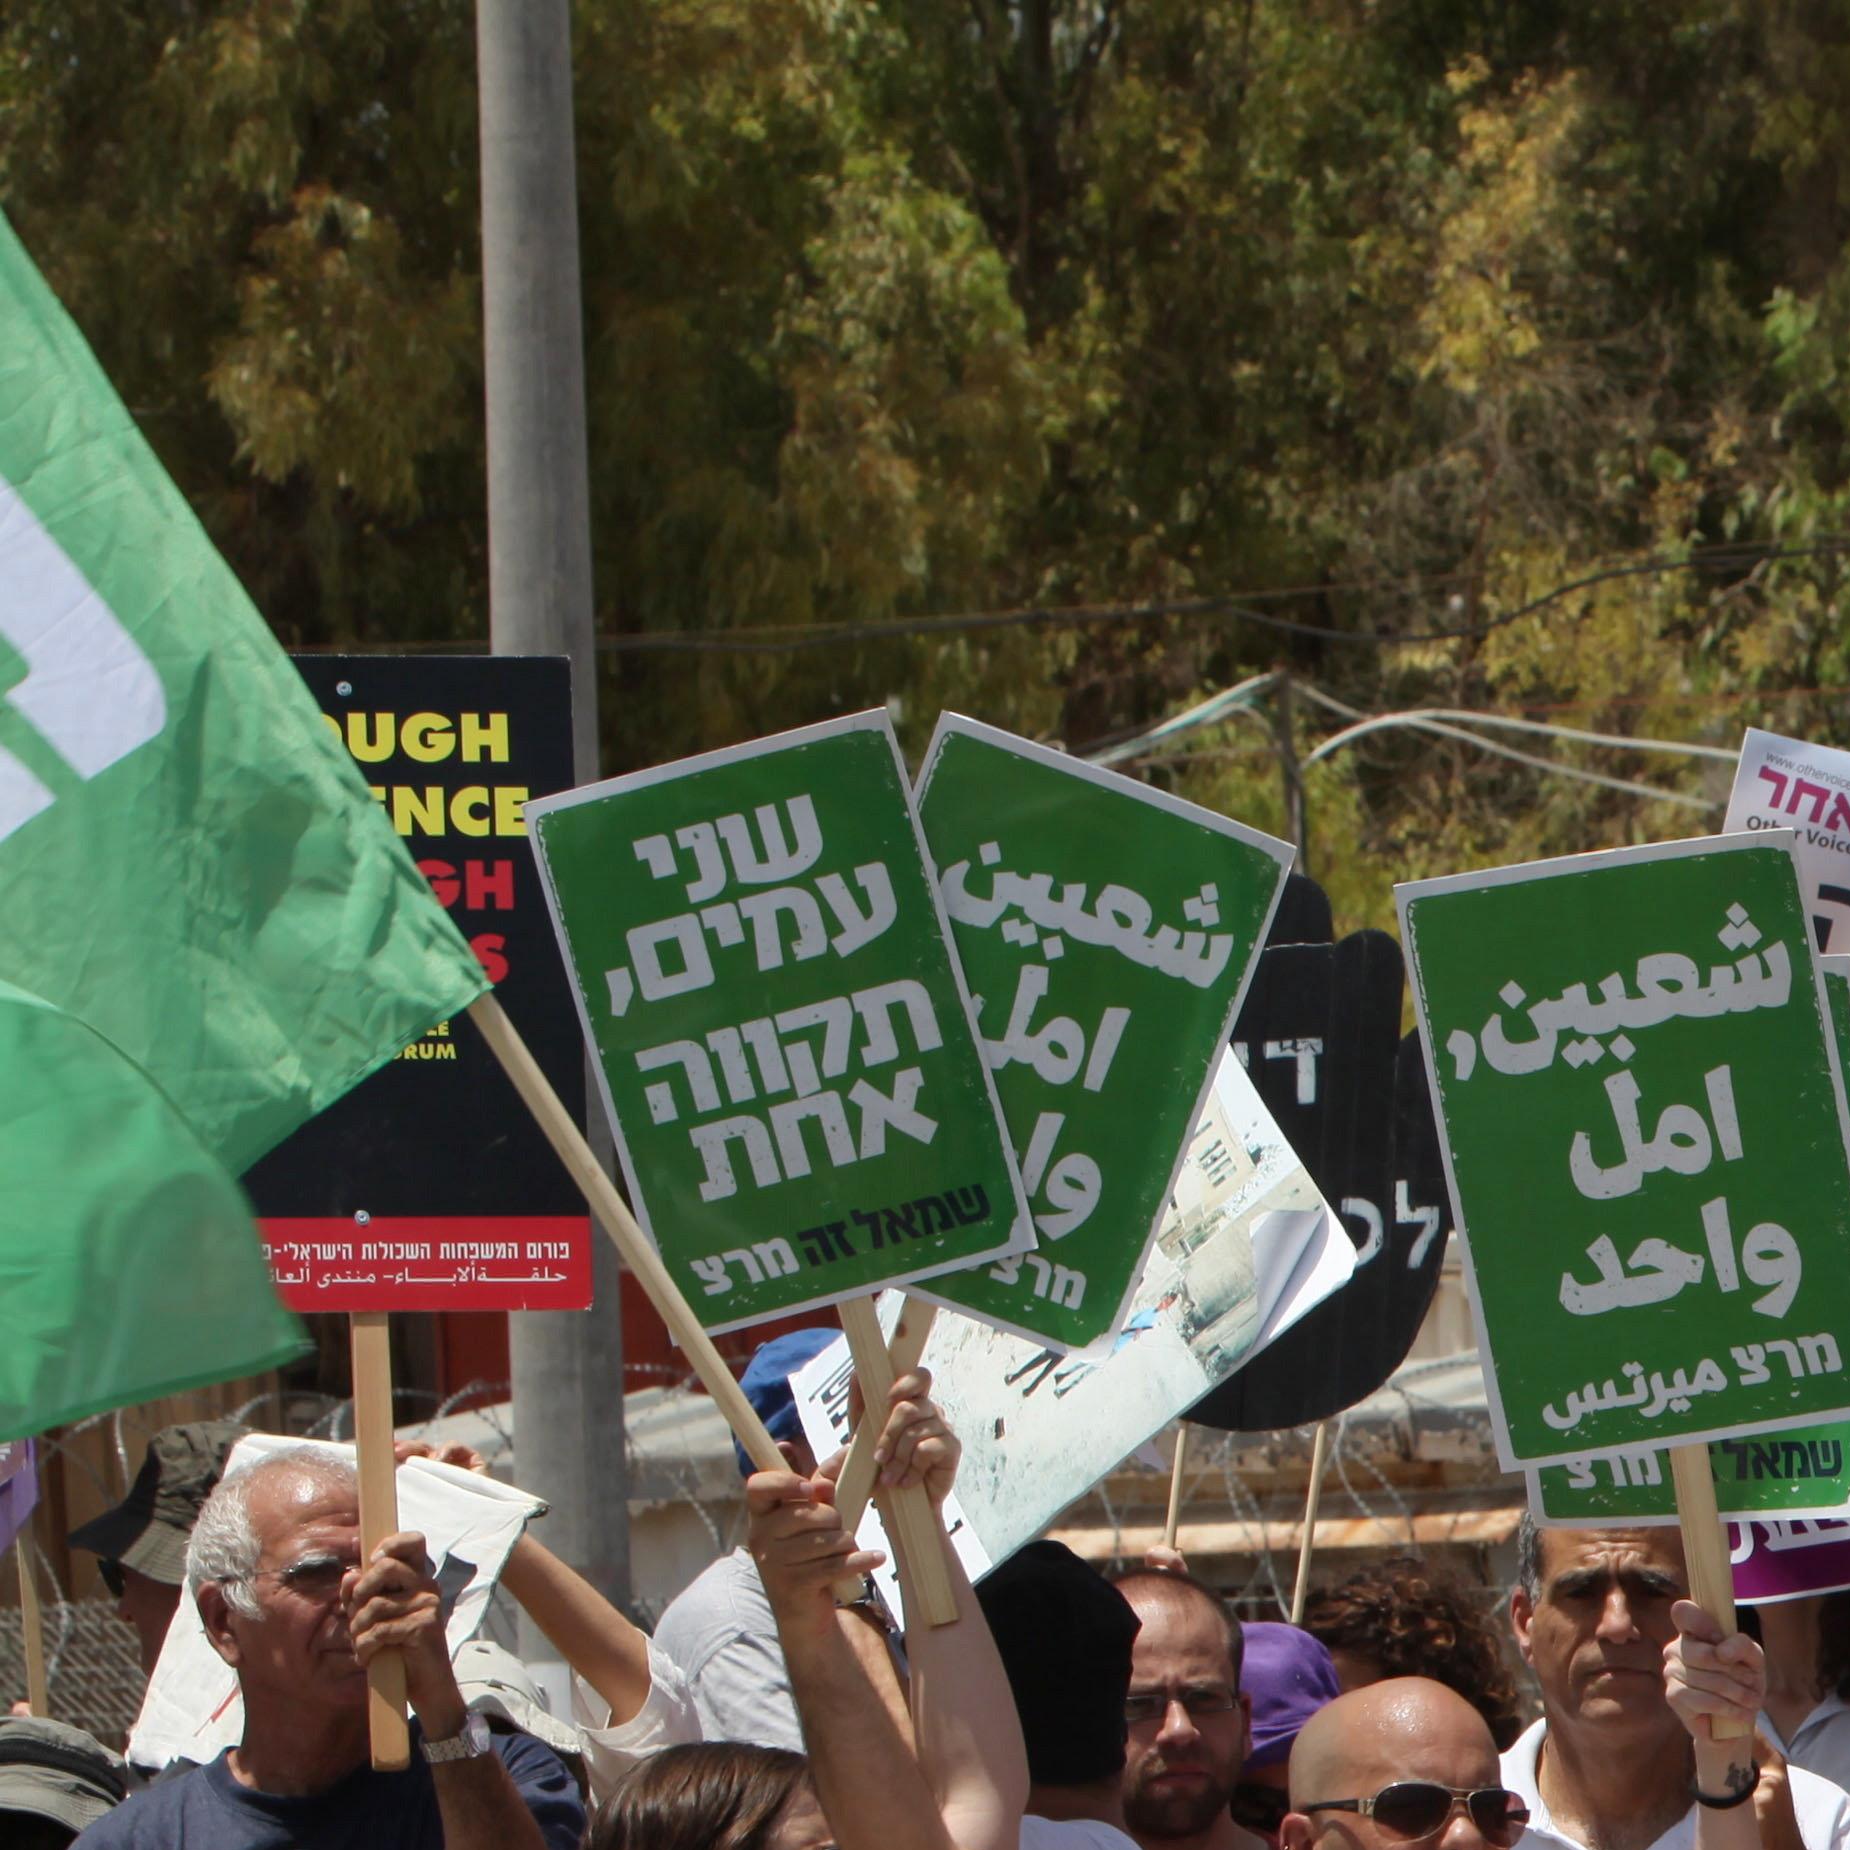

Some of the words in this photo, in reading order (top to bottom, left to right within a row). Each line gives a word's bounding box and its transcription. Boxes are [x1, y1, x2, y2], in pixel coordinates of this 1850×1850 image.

[633, 793, 823, 903] שני
[604, 862, 898, 1017] עמים,
[634, 979, 943, 1125] תקווה
[690, 1067, 939, 1203] אחת
[1570, 1064, 1743, 1200] امل
[362, 1238, 430, 1260] השכולות
[440, 1242, 518, 1261] המשפחות
[526, 1242, 570, 1259] פורום
[796, 1223, 855, 1269] זה
[854, 1183, 992, 1256] שמאל
[690, 1238, 799, 1297] מרצ
[1559, 1196, 1801, 1319] واحد
[1542, 1357, 1728, 1431] ميرتس
[1730, 1333, 1843, 1385] מרצ
[1722, 1438, 1842, 1480] שמאל
